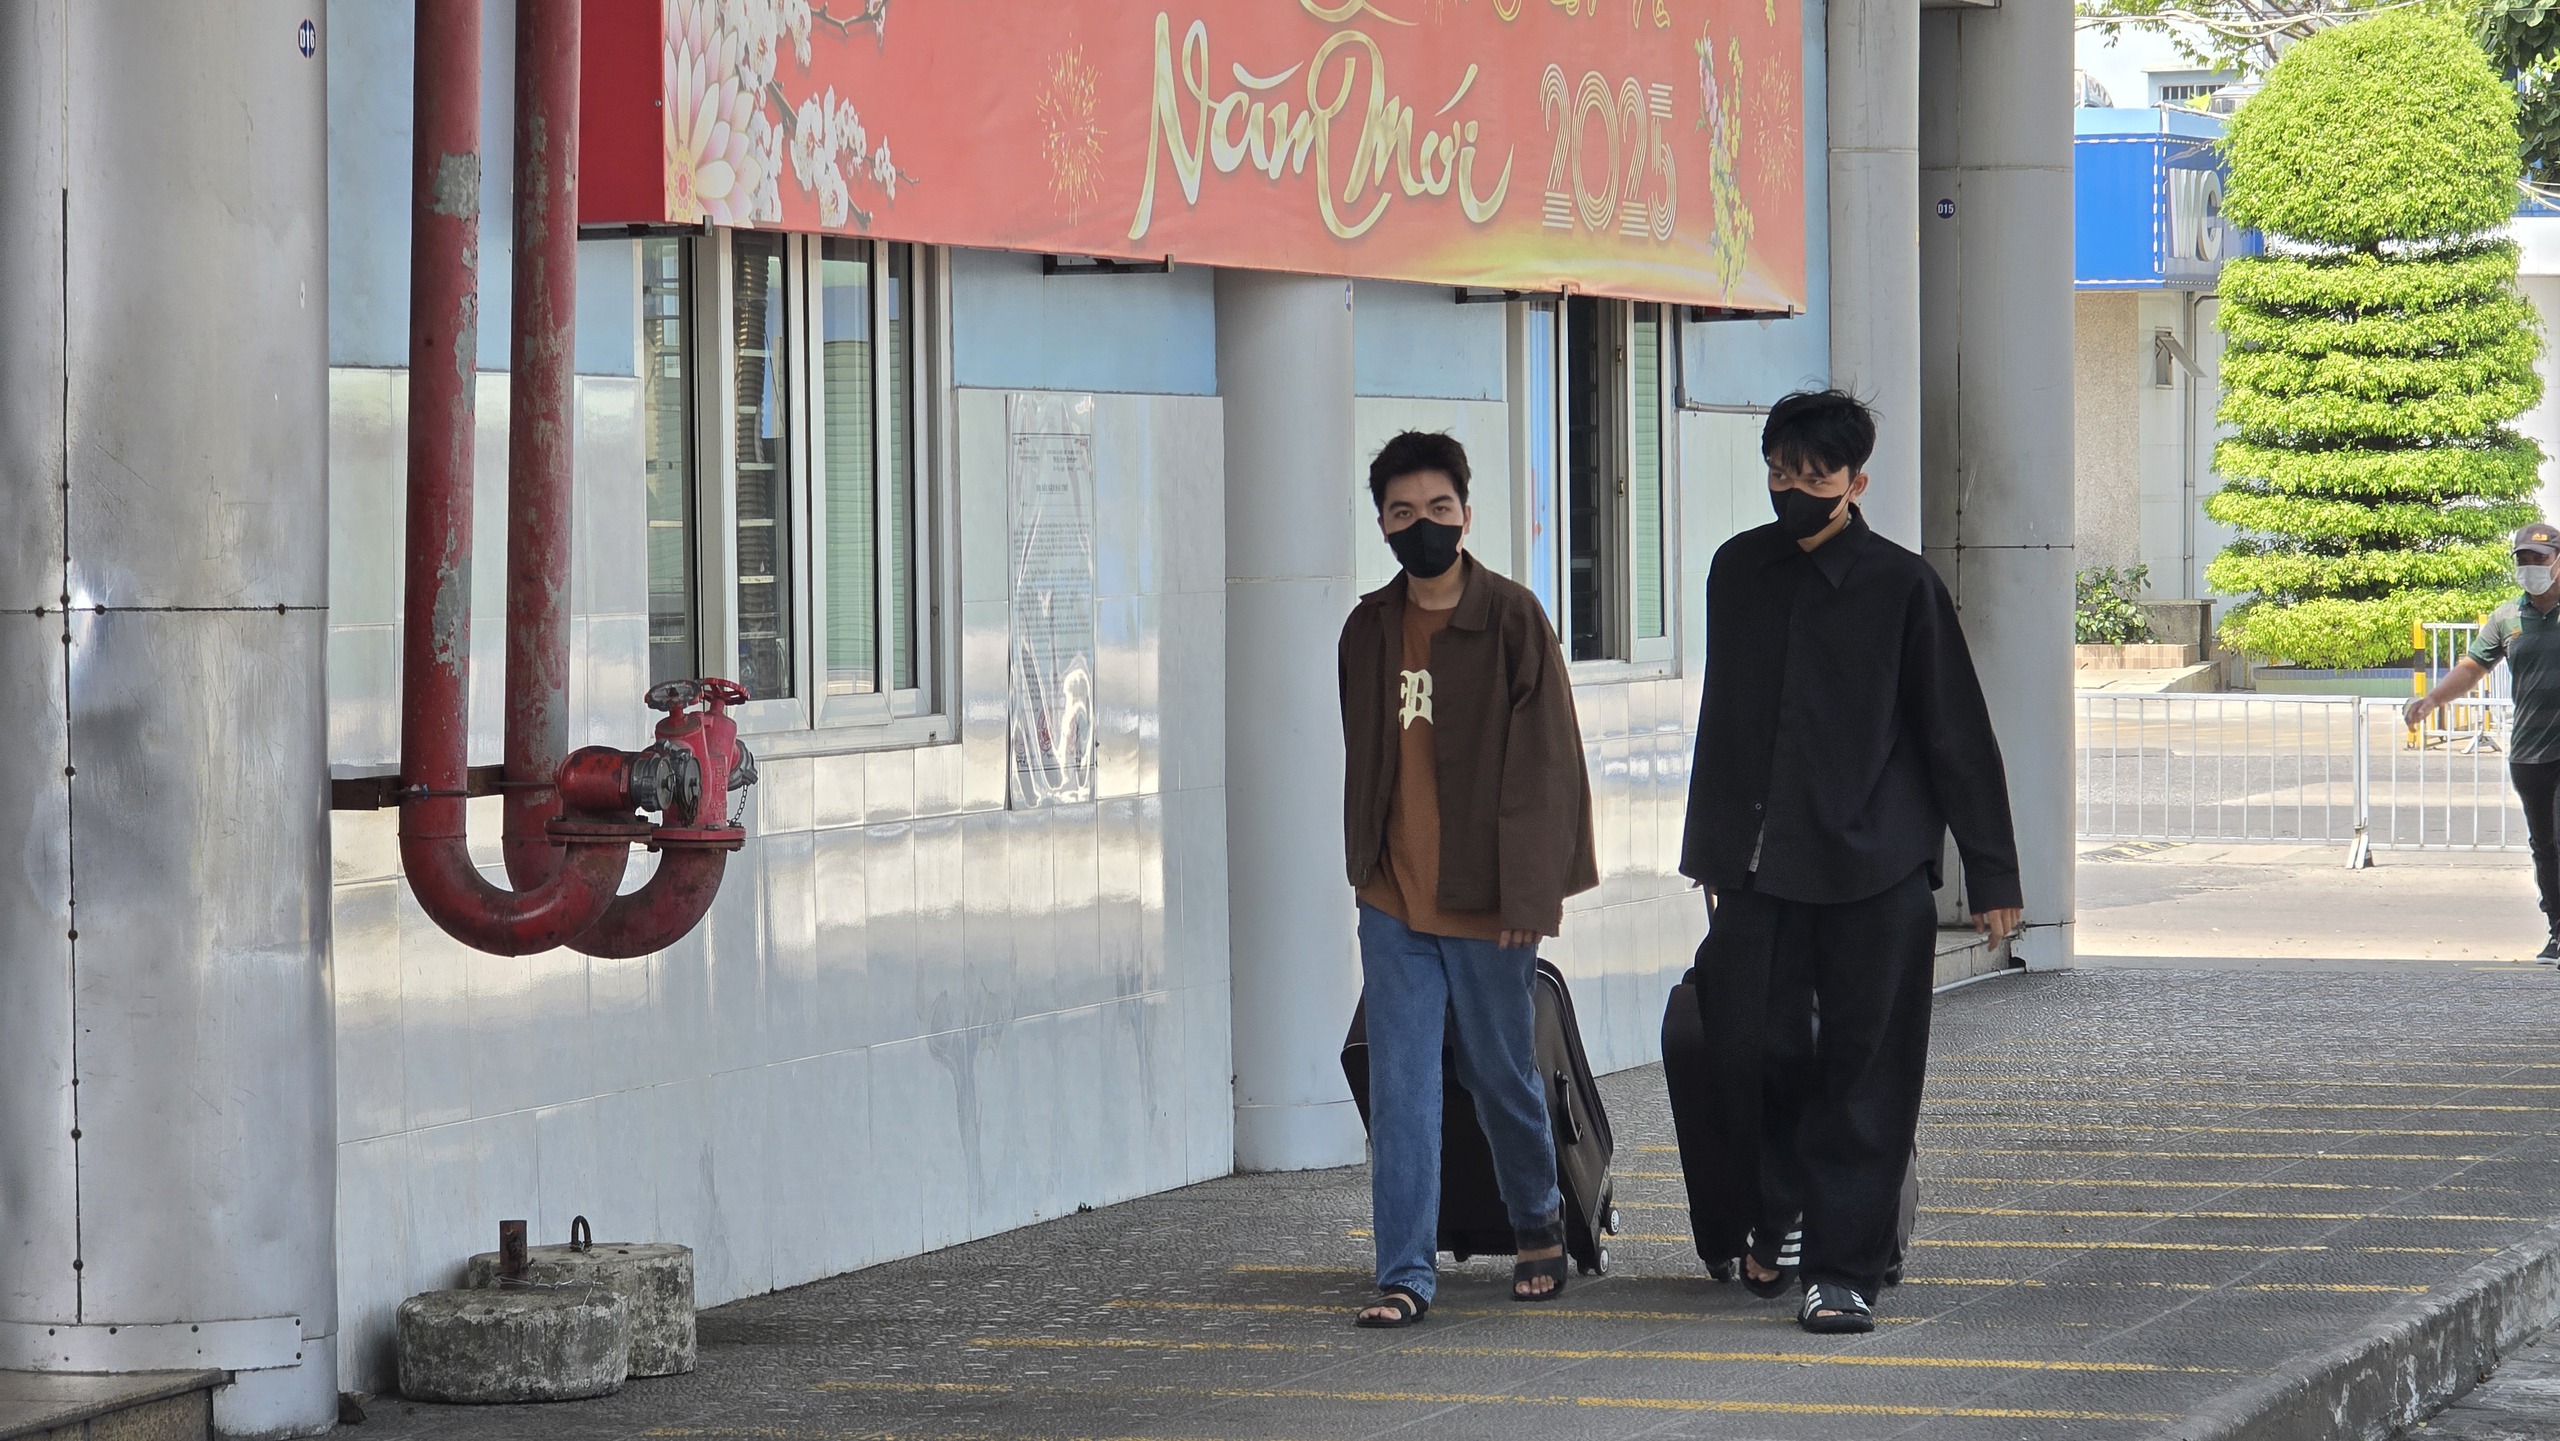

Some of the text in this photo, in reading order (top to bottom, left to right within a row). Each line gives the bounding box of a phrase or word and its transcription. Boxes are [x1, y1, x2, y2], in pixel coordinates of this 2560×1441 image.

[1128, 12, 1514, 240] Năm Mới
[1539, 63, 1677, 241] 2025
[2168, 167, 2223, 262] WC
[1399, 669, 1434, 731] B
